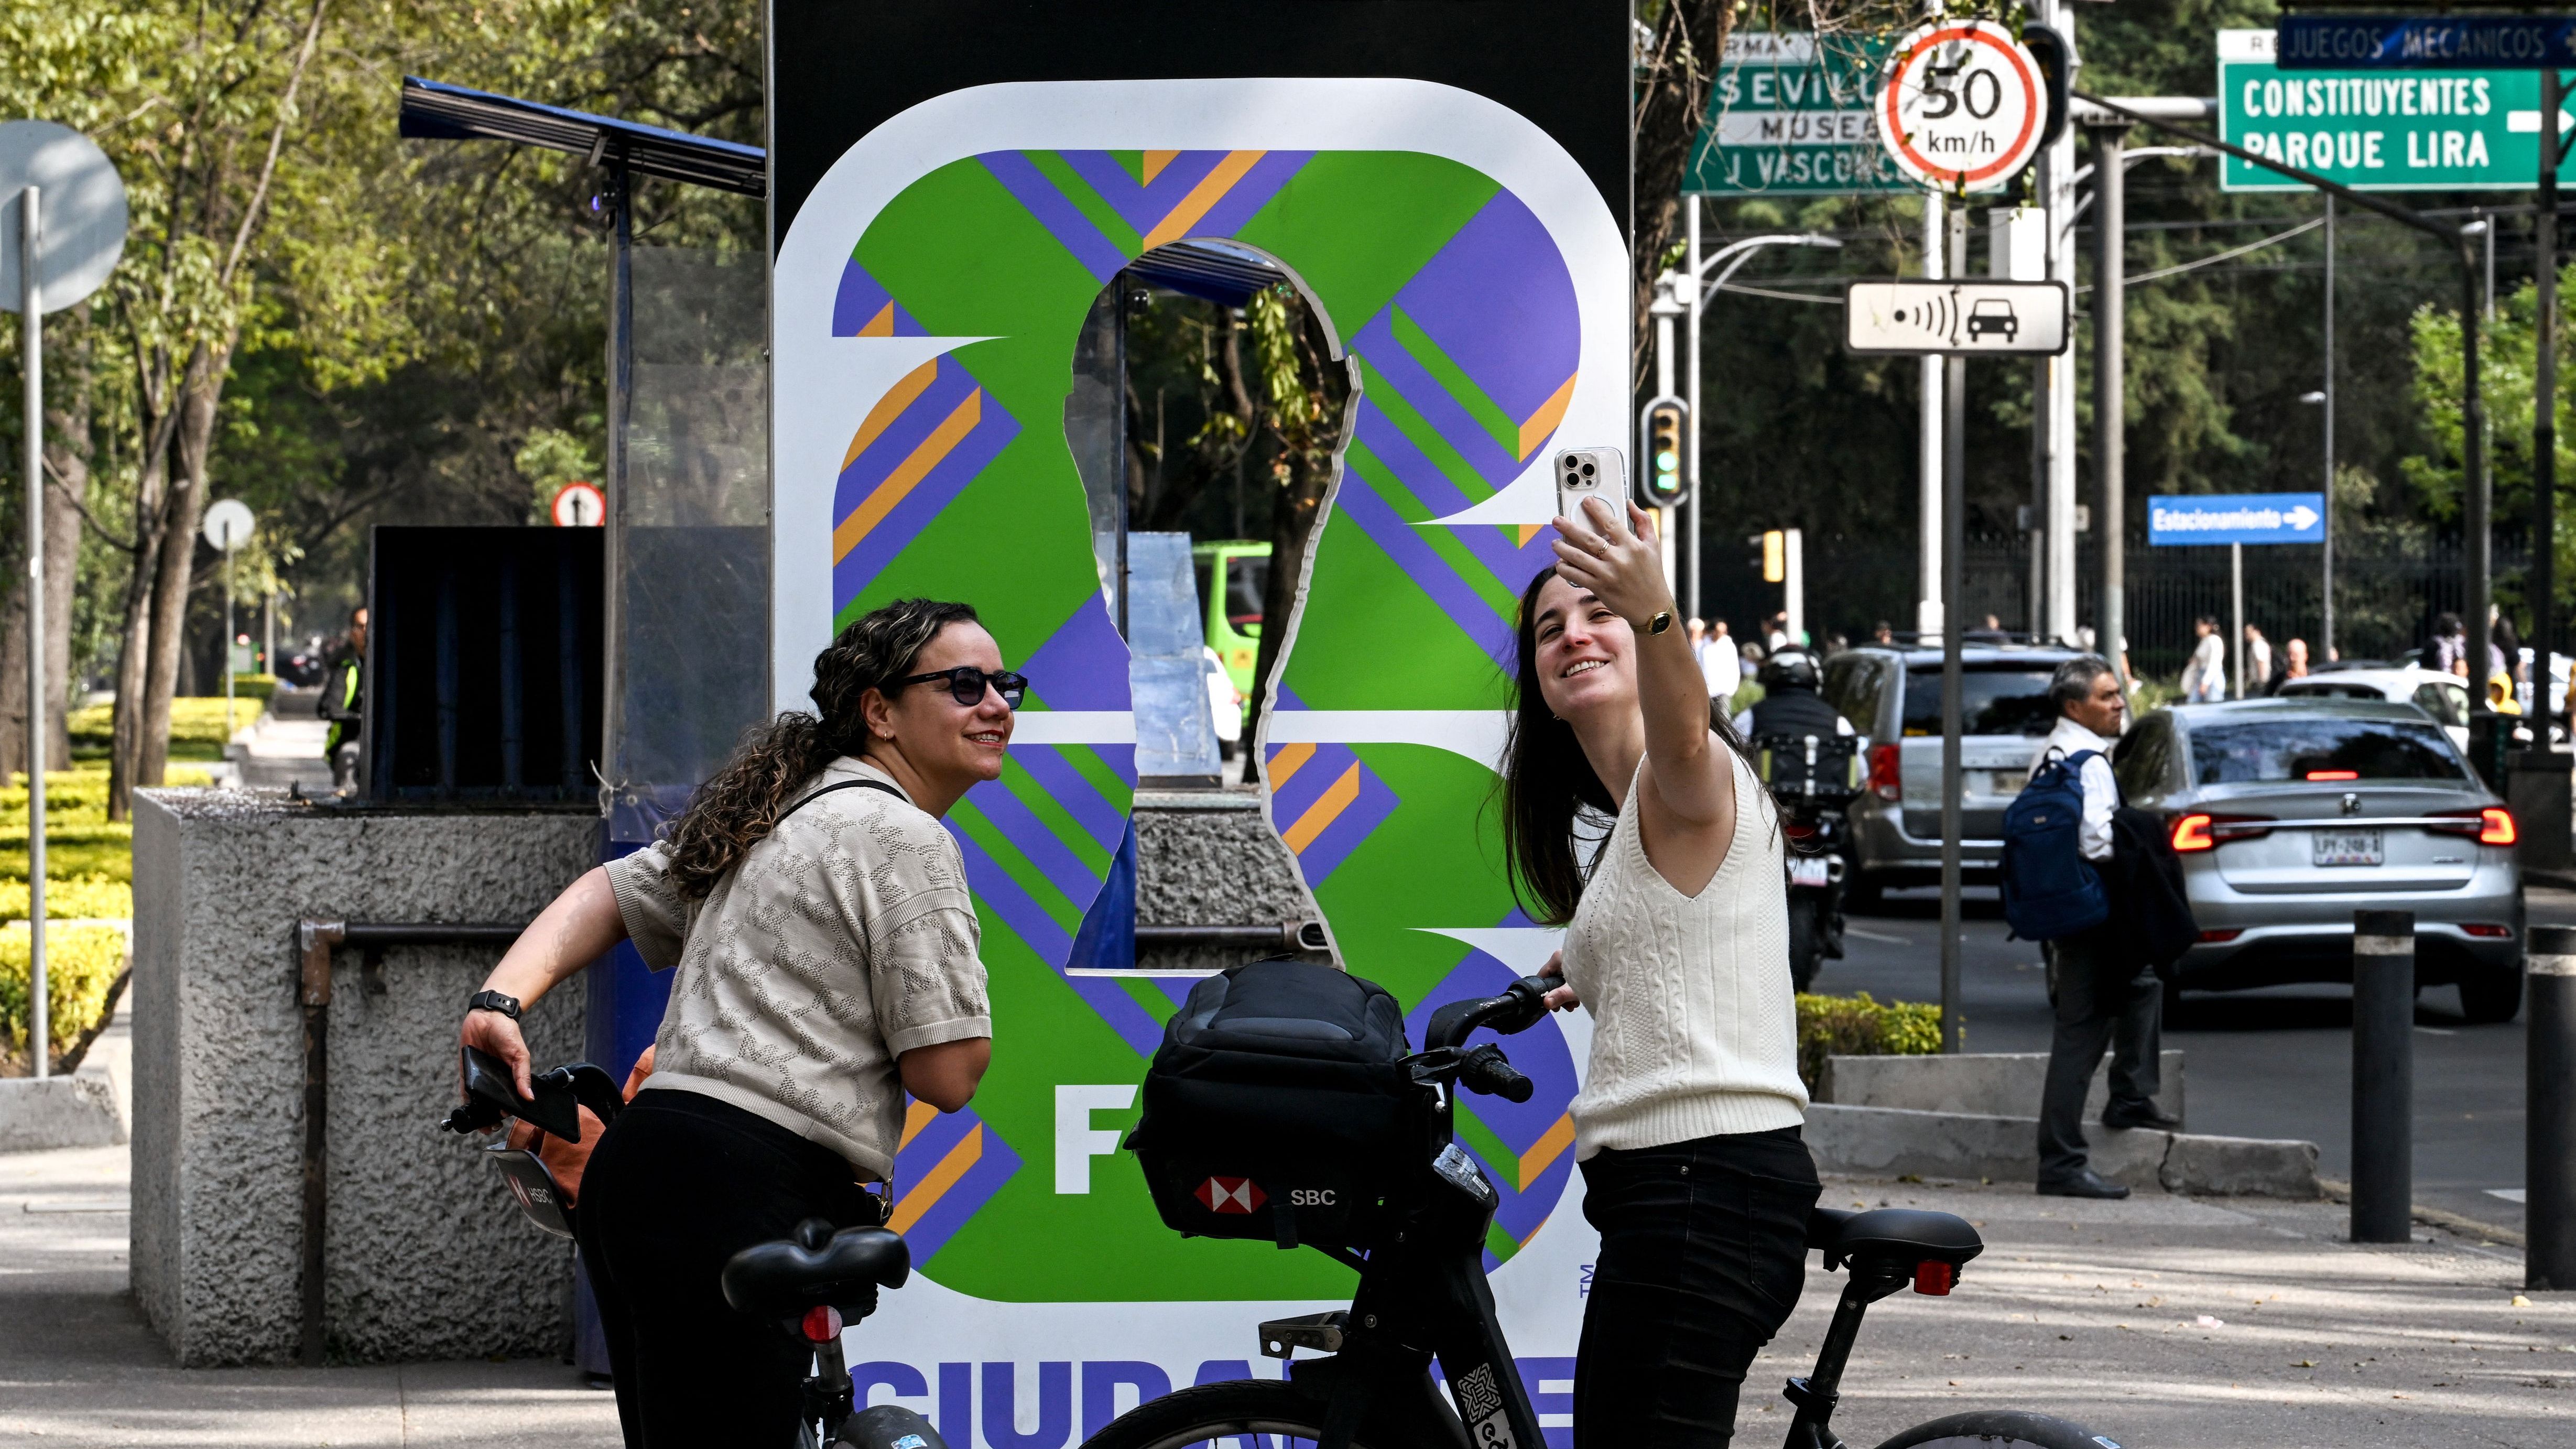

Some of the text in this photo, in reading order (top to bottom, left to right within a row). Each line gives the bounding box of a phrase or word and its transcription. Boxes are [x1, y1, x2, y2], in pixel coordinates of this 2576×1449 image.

[2288, 27, 2546, 58] JUEGOS MECANICOS
[1922, 67, 2001, 119] 50
[2244, 78, 2491, 117] CONSTITUYENTES
[1929, 130, 1995, 153] km/h
[2243, 130, 2490, 170] PARQUE LIRA
[527, 1187, 552, 1204] HSBC
[1290, 1189, 1336, 1206] SBC
[1580, 1265, 1594, 1298] TM
